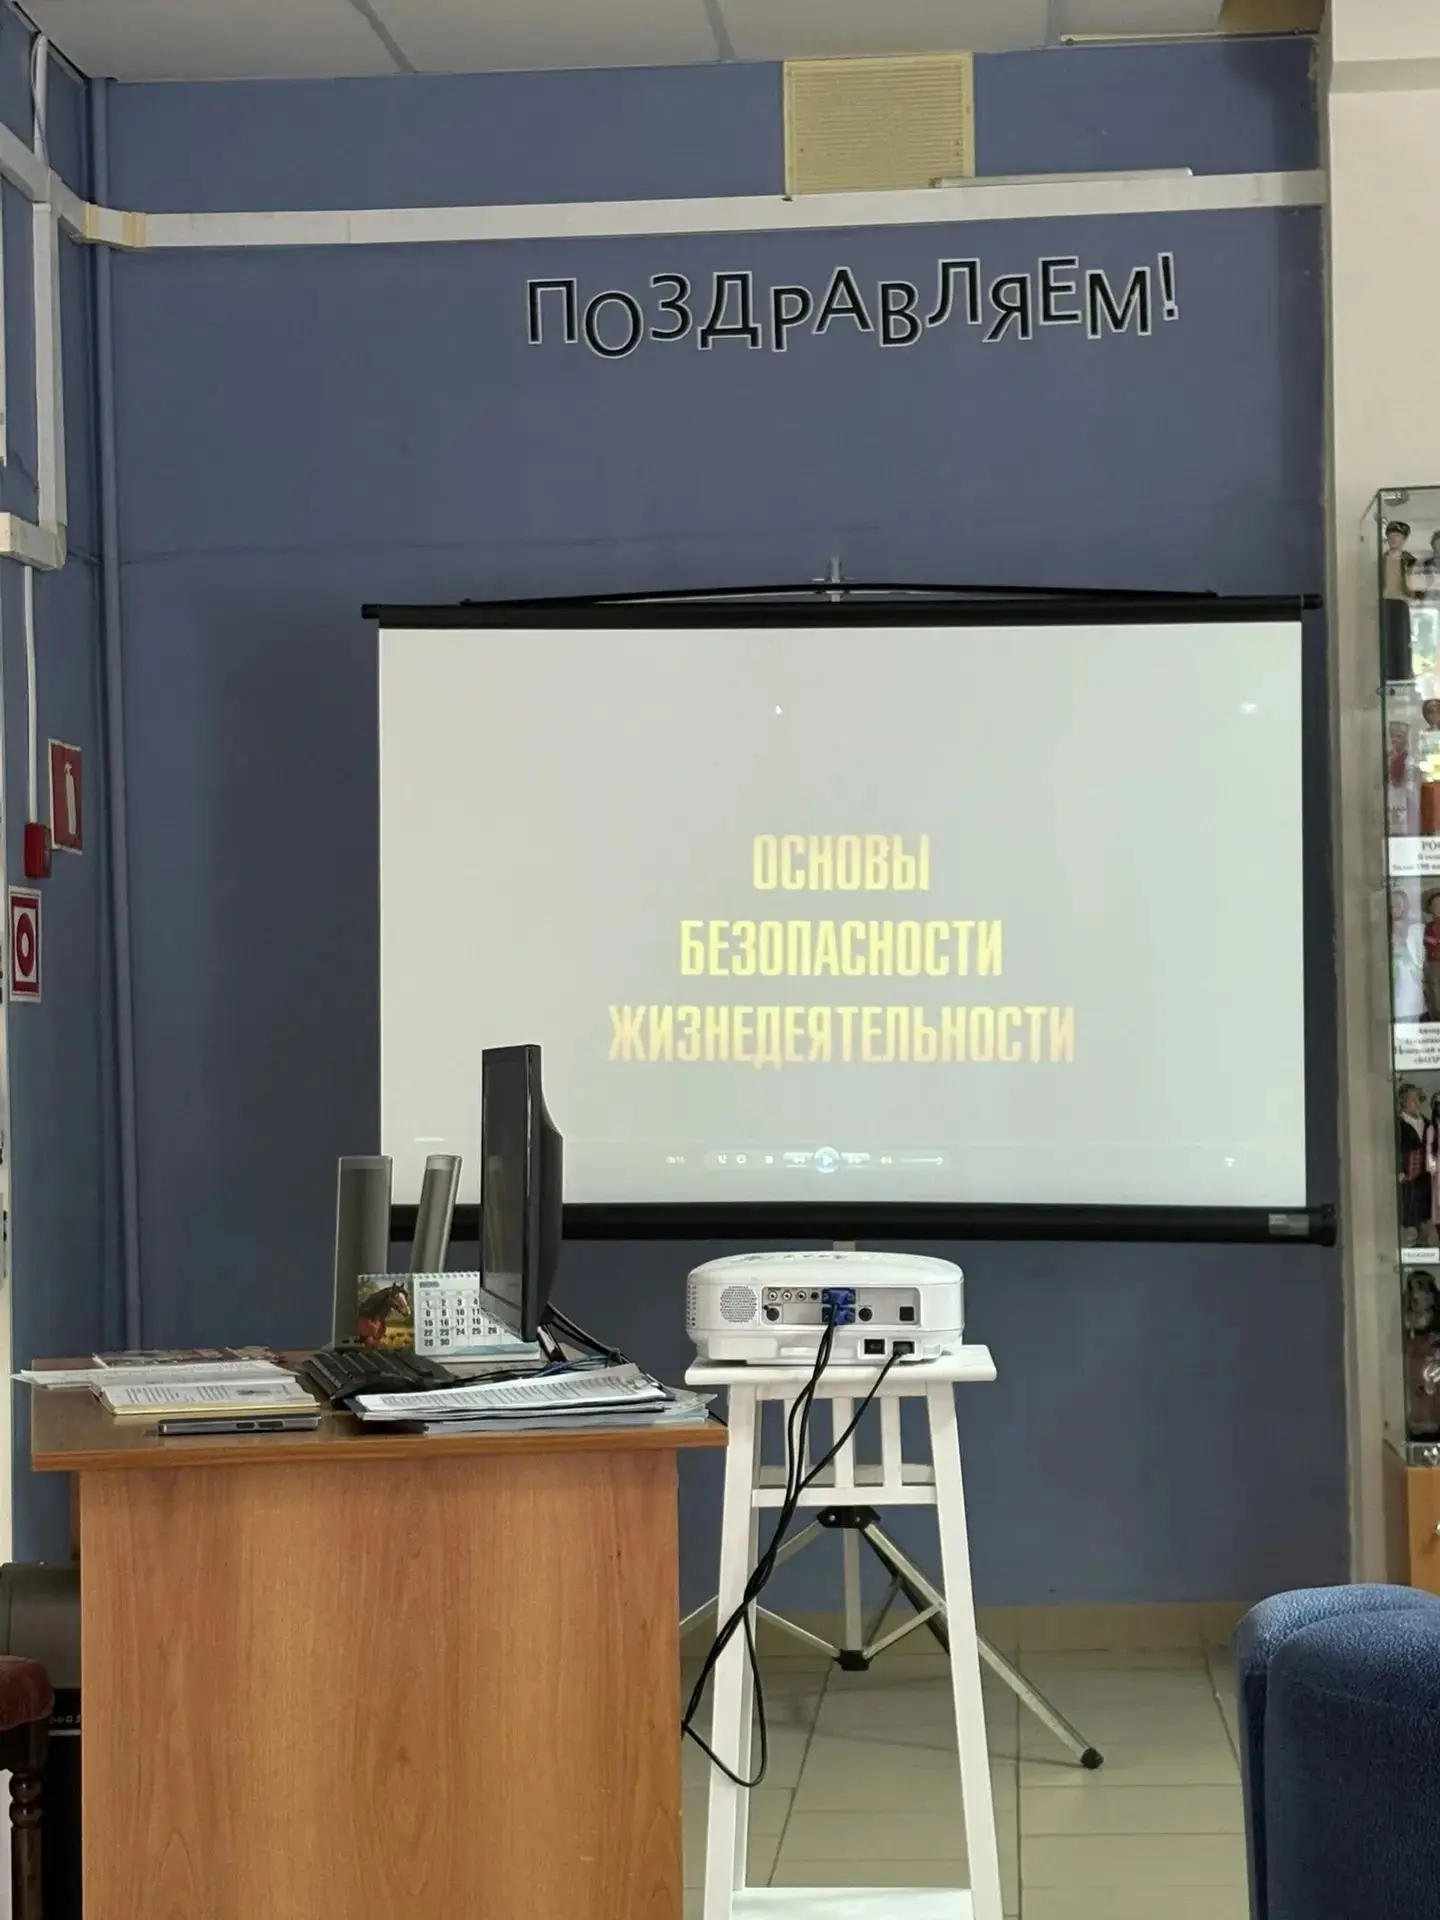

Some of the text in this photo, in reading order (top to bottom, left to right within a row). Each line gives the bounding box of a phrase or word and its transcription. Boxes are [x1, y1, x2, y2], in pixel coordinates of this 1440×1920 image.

[526, 251, 1179, 359] ПОЗДРАВЛЯЕМ!
[752, 833, 931, 892] ОСНОВЫ
[679, 919, 1004, 977] БЕЗОПАСНОСТИ
[607, 1003, 1076, 1071] ЖИЗНЕДЕЯТЕЛЬНОСТИ
[424, 1319, 434, 1327] 15
[440, 1319, 450, 1327] 16
[456, 1318, 465, 1326] 17
[456, 1308, 465, 1316] 10
[472, 1307, 480, 1315] 11
[424, 1329, 433, 1337] 22
[440, 1328, 449, 1336] 23
[456, 1328, 465, 1336] 24
[472, 1327, 481, 1335] 25
[488, 1326, 497, 1334] 26
[440, 1338, 450, 1346] 30
